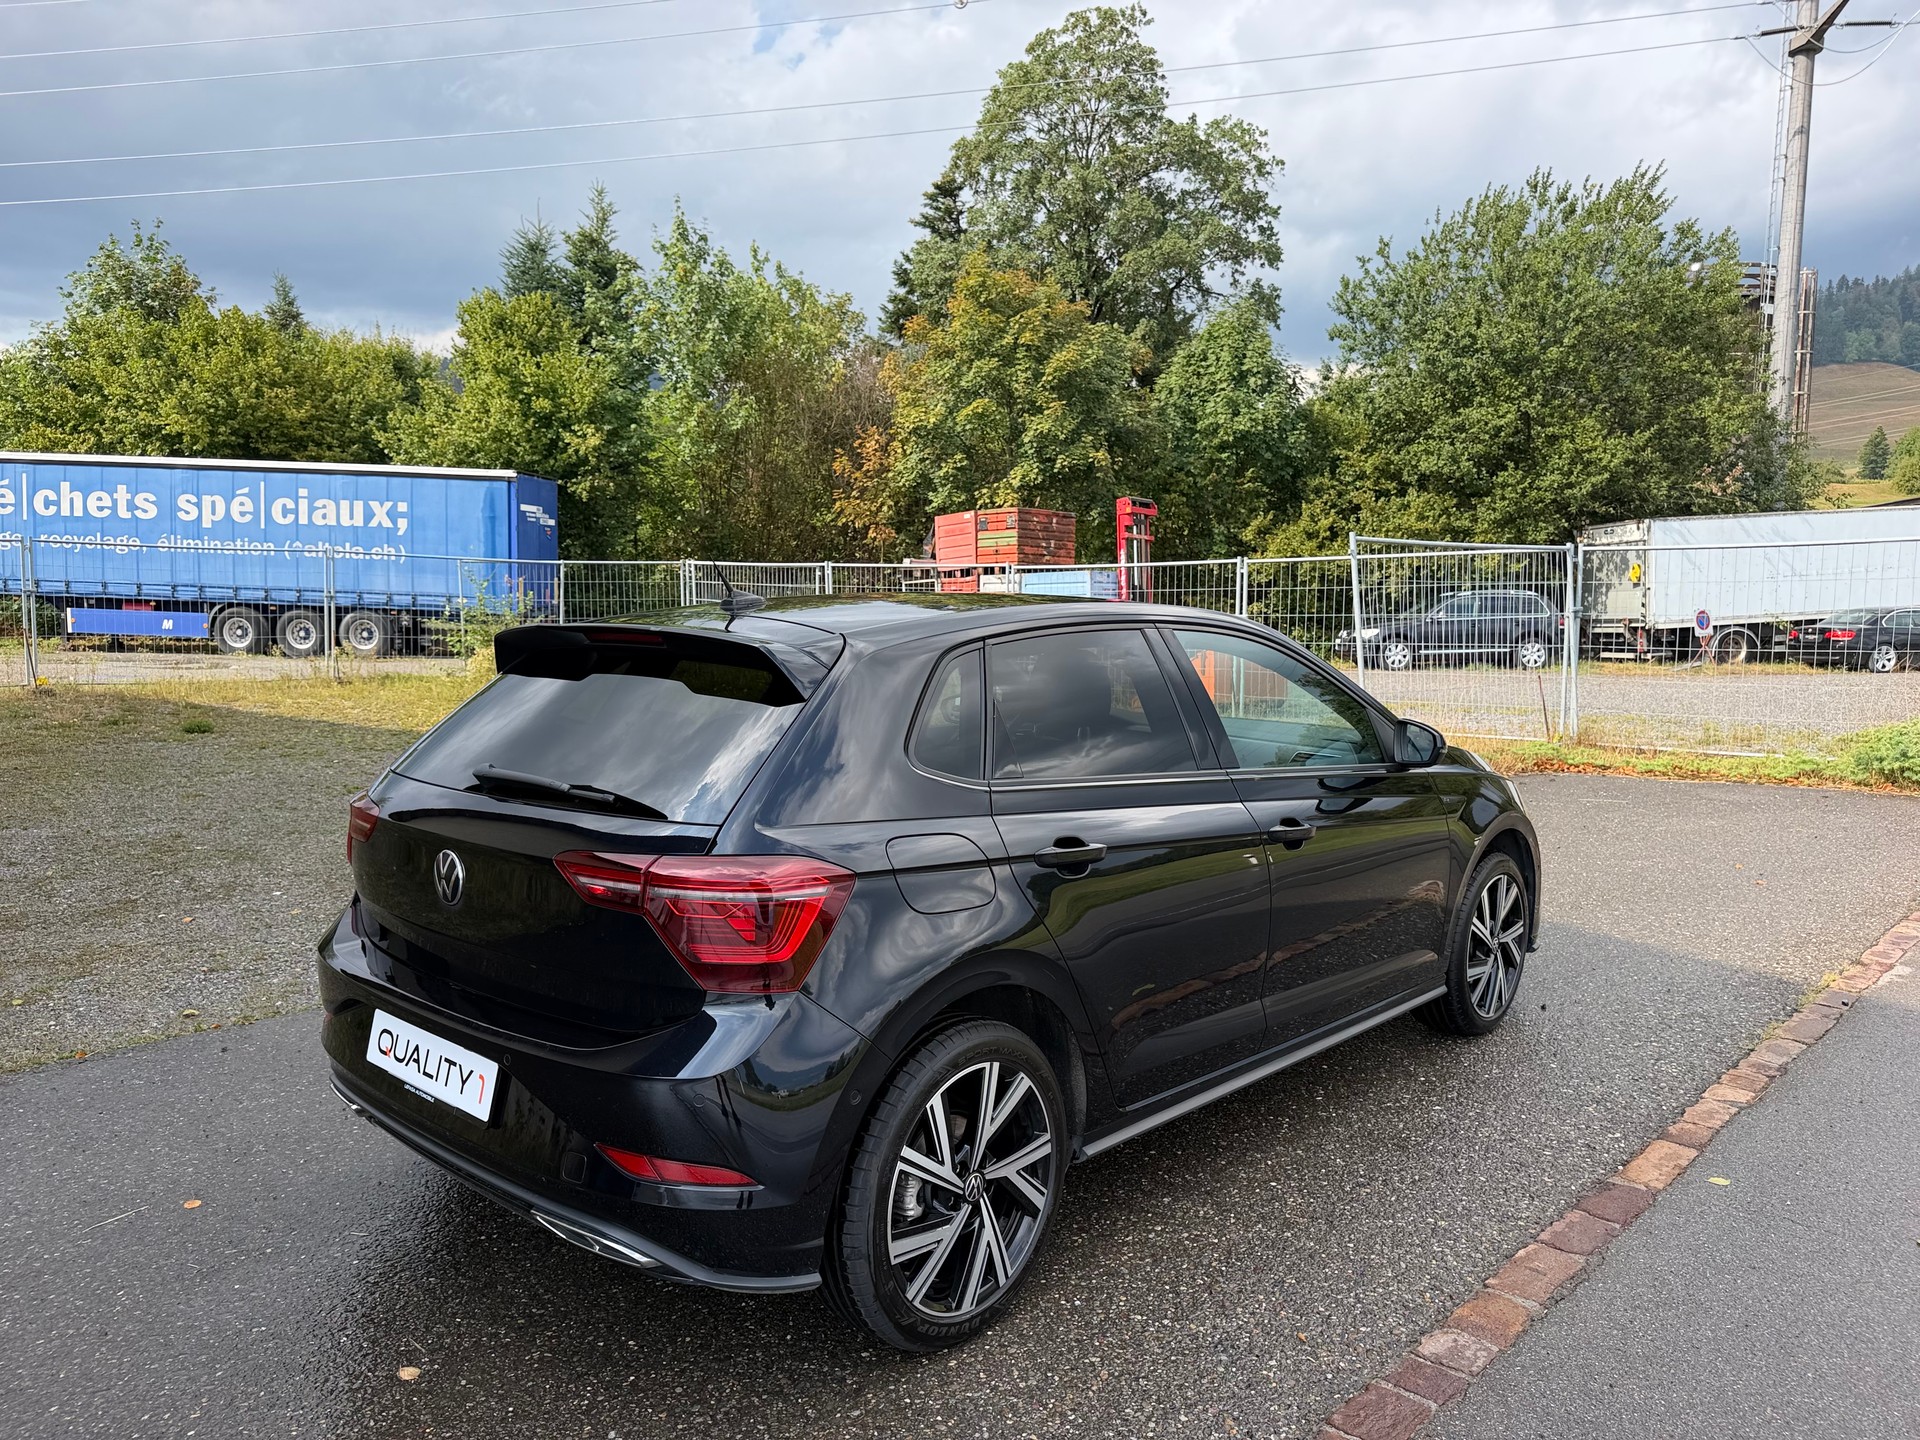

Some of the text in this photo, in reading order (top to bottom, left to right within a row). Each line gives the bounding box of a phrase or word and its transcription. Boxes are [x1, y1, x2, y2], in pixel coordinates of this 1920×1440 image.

[40, 532, 147, 554] recyclage,
[157, 533, 275, 556] élimination
[377, 1028, 474, 1095] QUALITY
[957, 1046, 997, 1065] SPORT
[916, 1315, 982, 1337] DUNLOP
